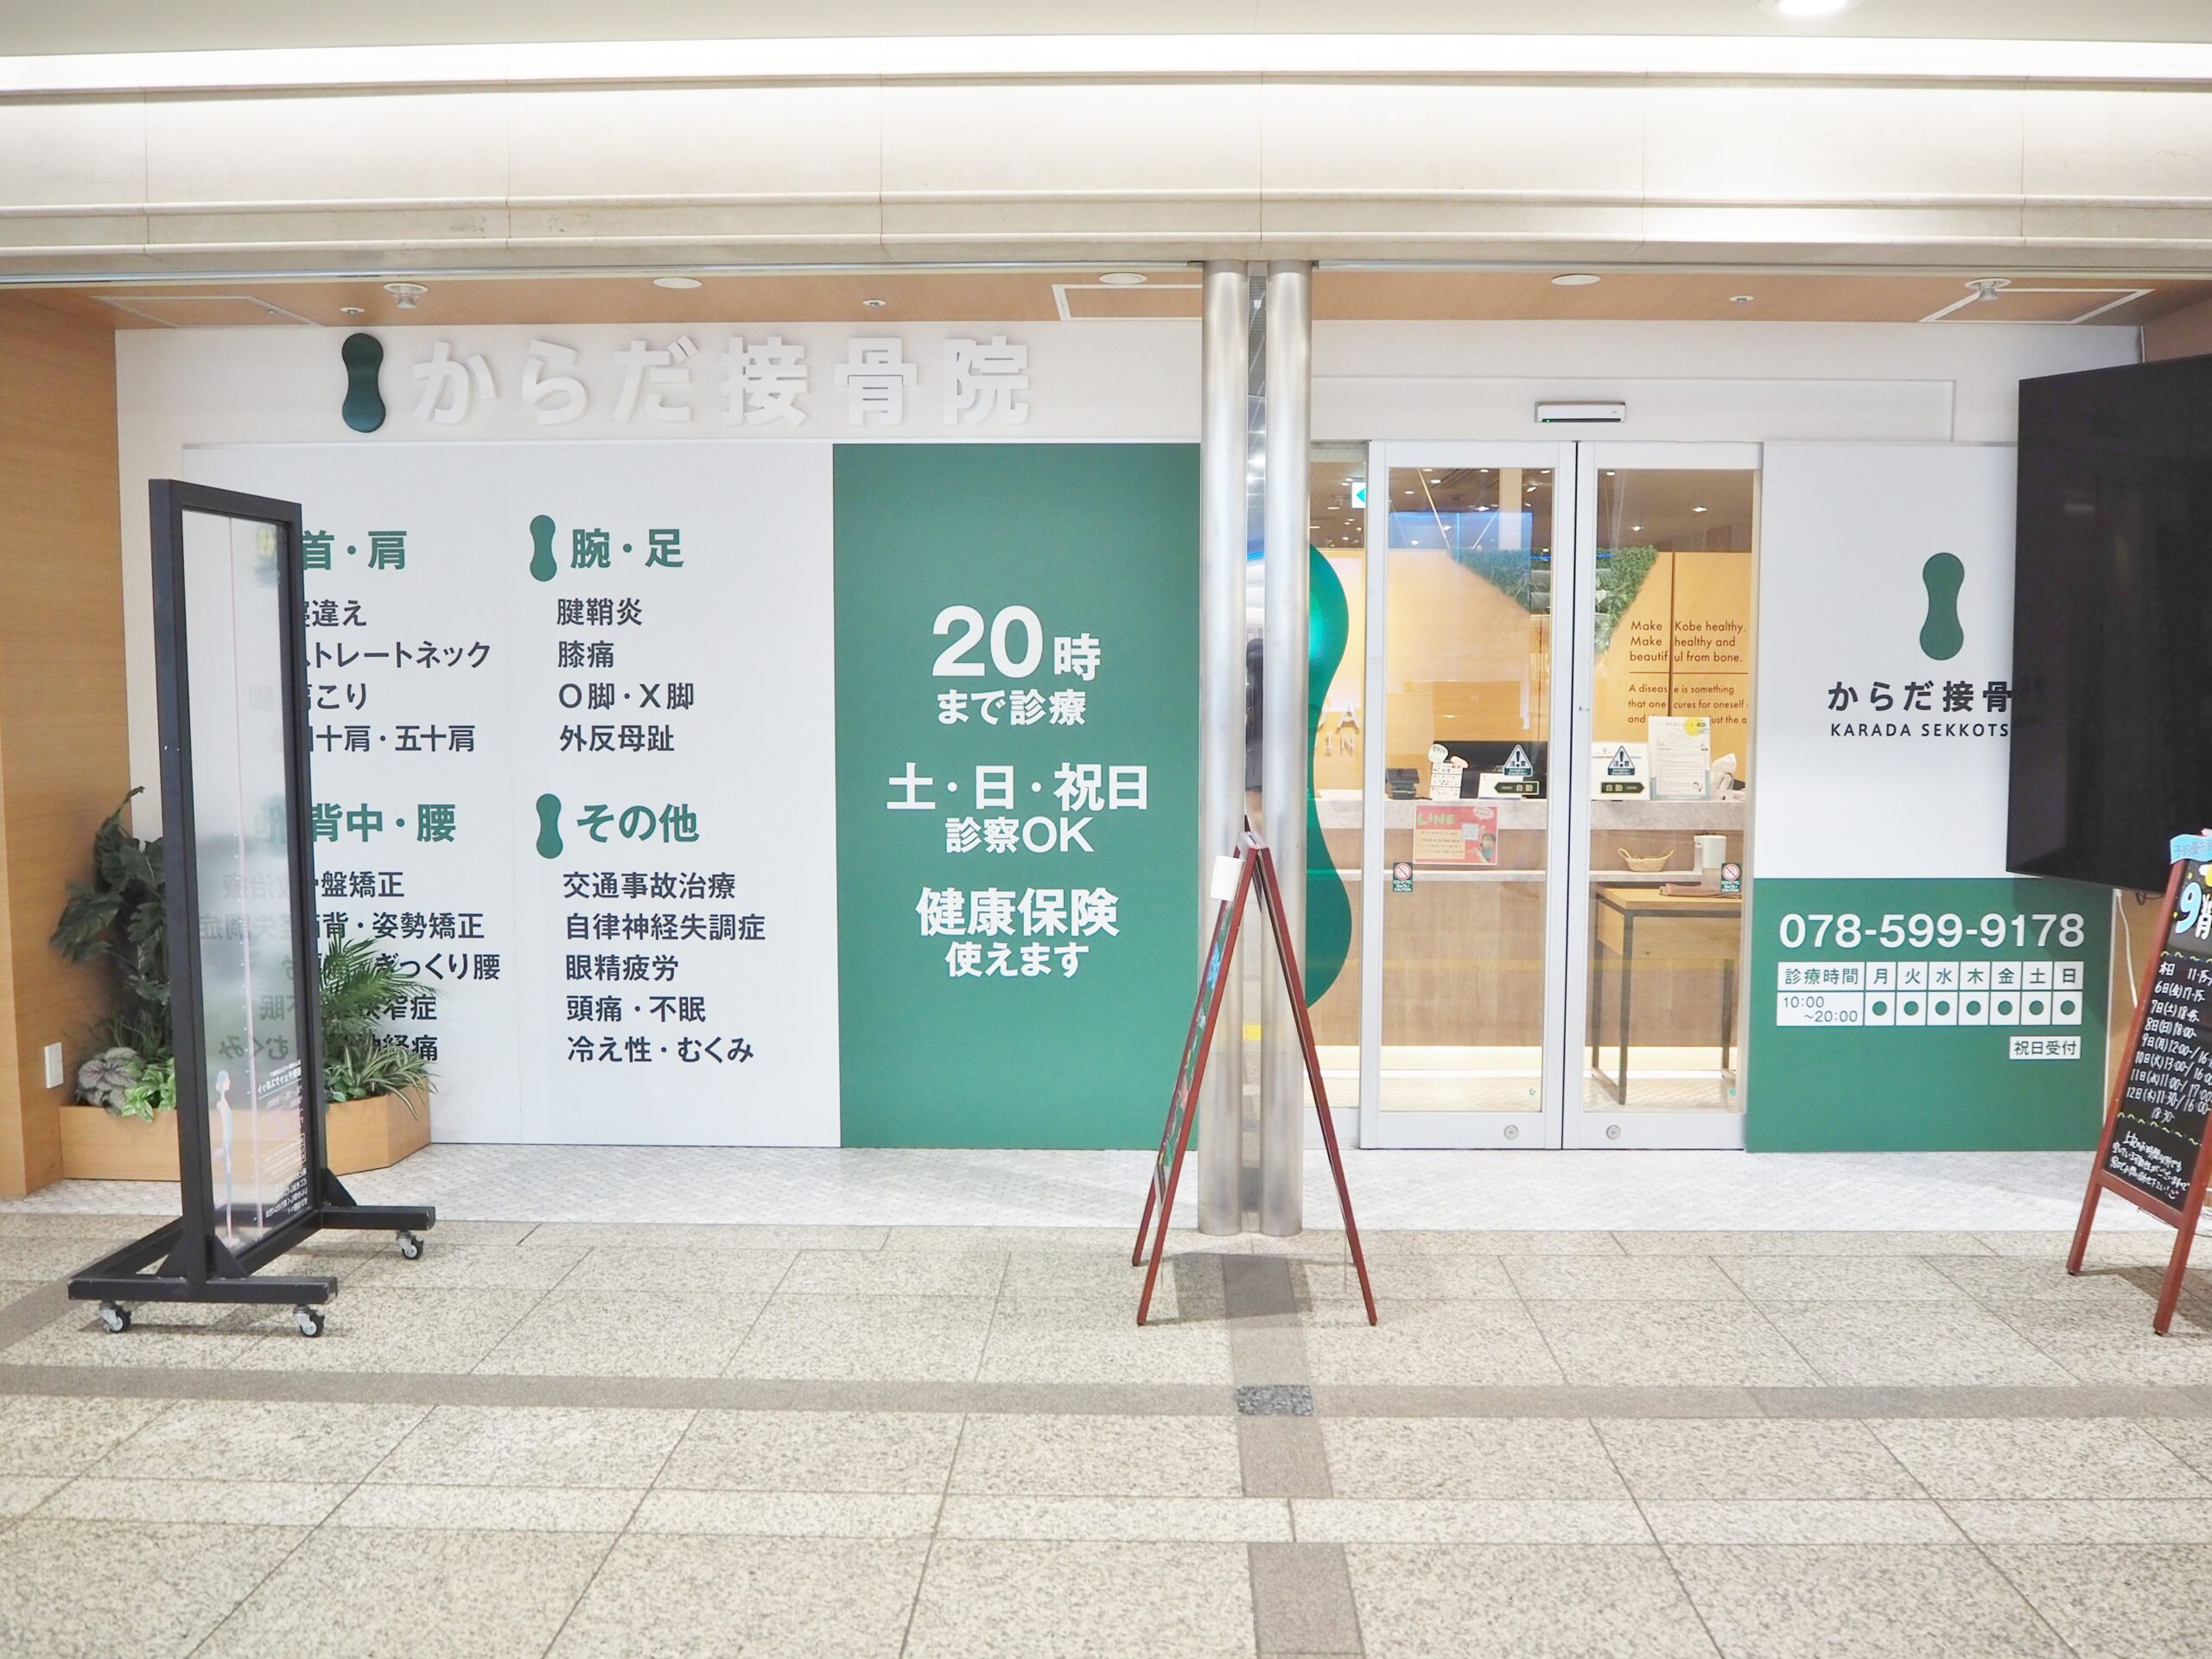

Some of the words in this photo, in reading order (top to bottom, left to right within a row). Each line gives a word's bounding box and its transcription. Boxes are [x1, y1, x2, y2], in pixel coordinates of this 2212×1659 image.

[411, 335, 1029, 426] からだ接骨院
[303, 531, 407, 571] 首・肩
[570, 528, 684, 569] 腕・足
[556, 598, 643, 626] 腱鞘炎
[1630, 620, 1662, 631] Make
[1675, 620, 1702, 632] Kobe
[1706, 620, 1746, 634] healthy.
[306, 640, 491, 670] トレートネック
[557, 640, 614, 668] 膝痛
[932, 605, 1101, 681] 20時
[1630, 636, 1662, 646] Make
[1675, 636, 1712, 649] healthy
[1716, 637, 1736, 647] and
[1687, 651, 1710, 662] from
[1713, 652, 1743, 663] bone.
[307, 683, 367, 711] こり
[1628, 699, 1646, 709] that
[1699, 699, 1711, 709] for
[1713, 699, 1745, 709] oneself
[1681, 684, 1688, 693] is
[1691, 685, 1734, 696] something
[1827, 680, 2012, 713] からだ接骨
[937, 689, 1087, 726] まで診療
[1628, 715, 1646, 723] and
[1726, 715, 1738, 724] the
[308, 724, 475, 753] 十肩・五十肩
[560, 724, 674, 752] 外反母趾
[1831, 723, 1910, 736] KARADA
[1922, 723, 2009, 736] SEKKOTS
[887, 762, 1147, 811] 土・日・祝日
[312, 803, 456, 842] 背中・腰
[576, 803, 700, 843] その他
[1417, 812, 1455, 826] LINE
[945, 816, 1094, 854] 診察OK
[315, 871, 404, 898] 盤矯正
[563, 871, 735, 899] 交通事故治療
[316, 912, 485, 939] 背・姿勢矯正
[567, 912, 766, 940] 自律神経失調症
[915, 887, 1119, 937] 健康保険
[1779, 912, 2085, 949] 078-599-9178
[566, 954, 678, 982] 眼精疲労
[945, 942, 1089, 978] 使えます
[1785, 968, 1859, 985] 診療時間
[1873, 968, 1888, 984] 月
[1905, 969, 1921, 984] 火
[1936, 969, 1953, 984] 水
[1967, 968, 1984, 984] 木
[1999, 968, 2015, 984] 金
[2030, 969, 2045, 984] 土
[2063, 969, 2075, 983] 日
[567, 995, 706, 1022] 頭痛・不眠
[1783, 995, 1824, 1008] 10:00
[568, 1036, 753, 1063] 冷え性・むくみ
[2014, 1040, 2077, 1056] 祝日受付
